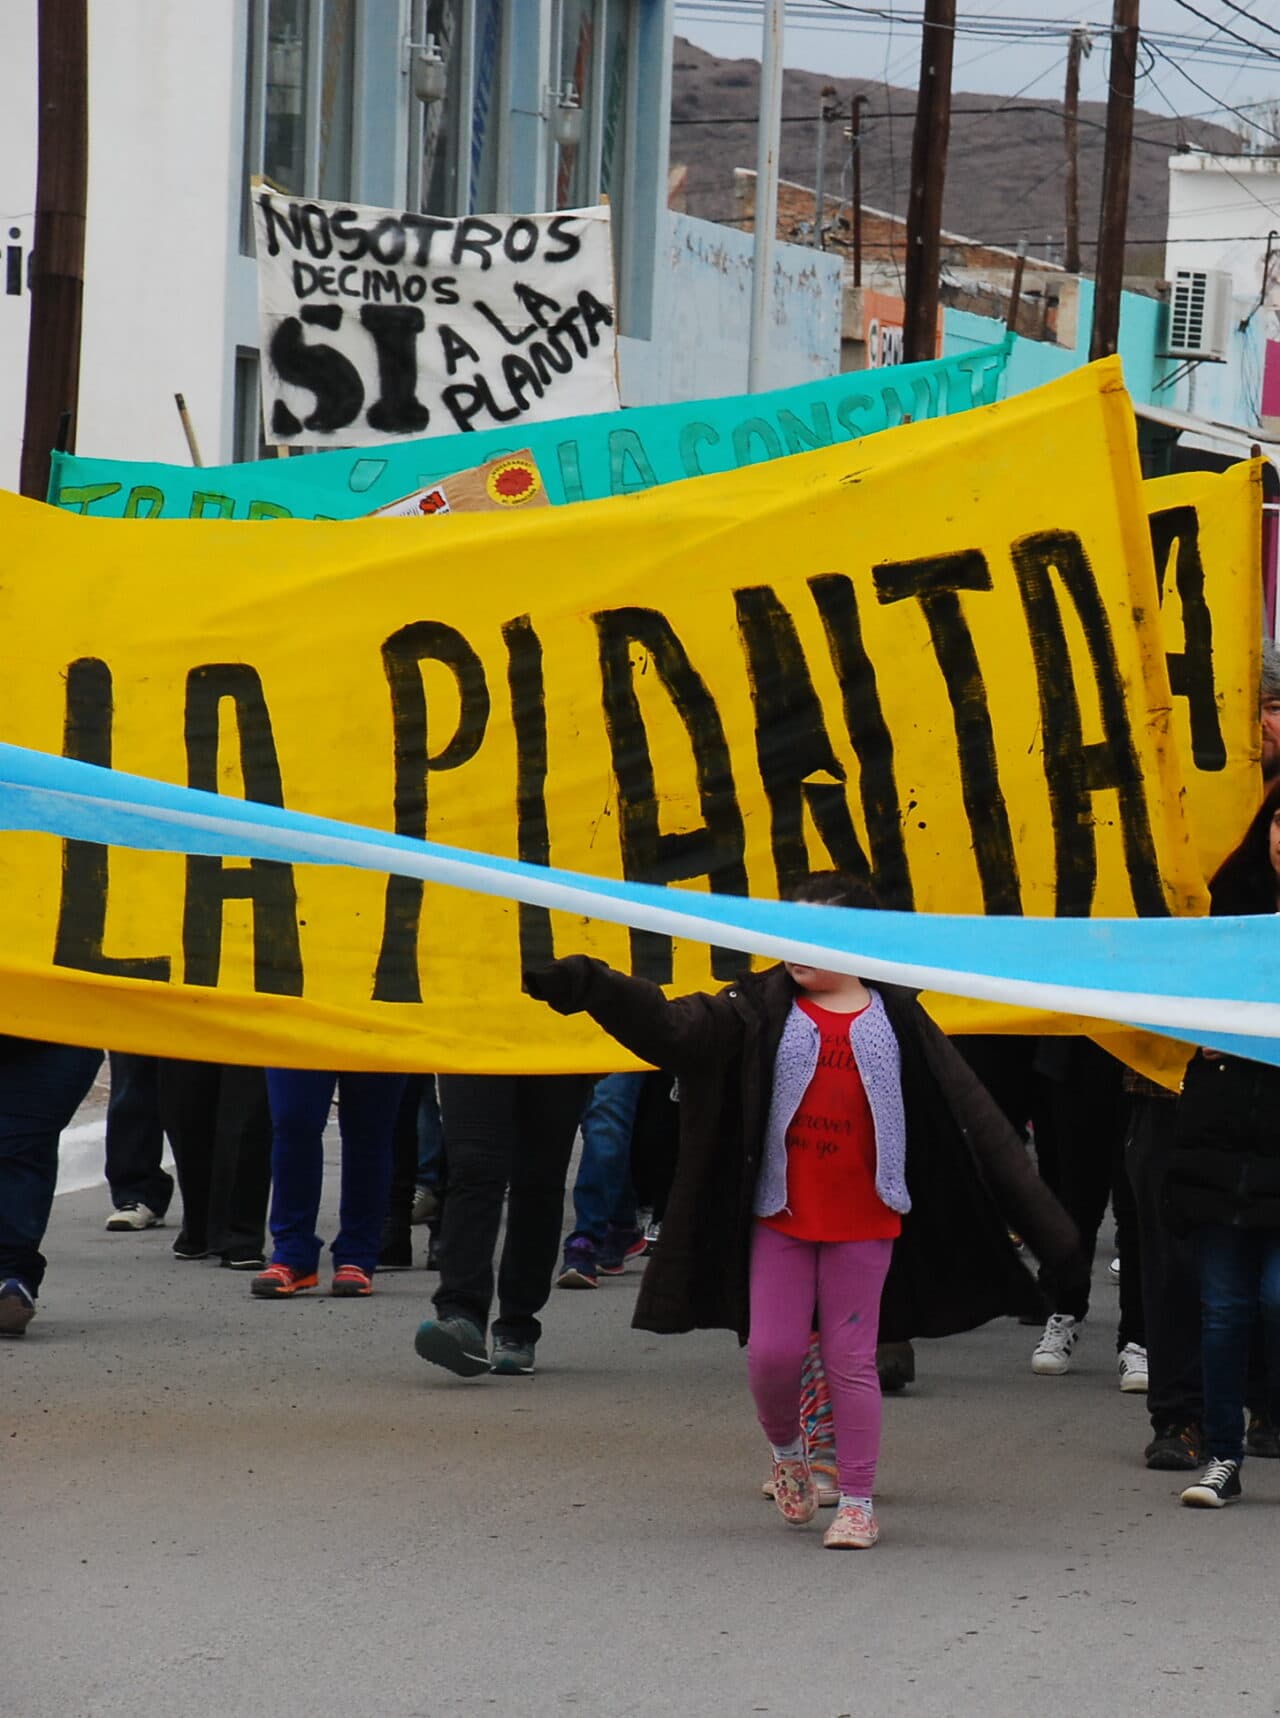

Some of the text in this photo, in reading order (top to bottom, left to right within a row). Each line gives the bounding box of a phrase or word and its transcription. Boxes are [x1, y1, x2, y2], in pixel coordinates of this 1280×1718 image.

[257, 194, 581, 271] NOSOTROS
[292, 259, 460, 304] DECIMOS
[270, 303, 430, 437] SI
[438, 281, 561, 375] A LA
[441, 290, 614, 432] PLANTA
[53, 528, 1172, 1004] LA PLANTA
